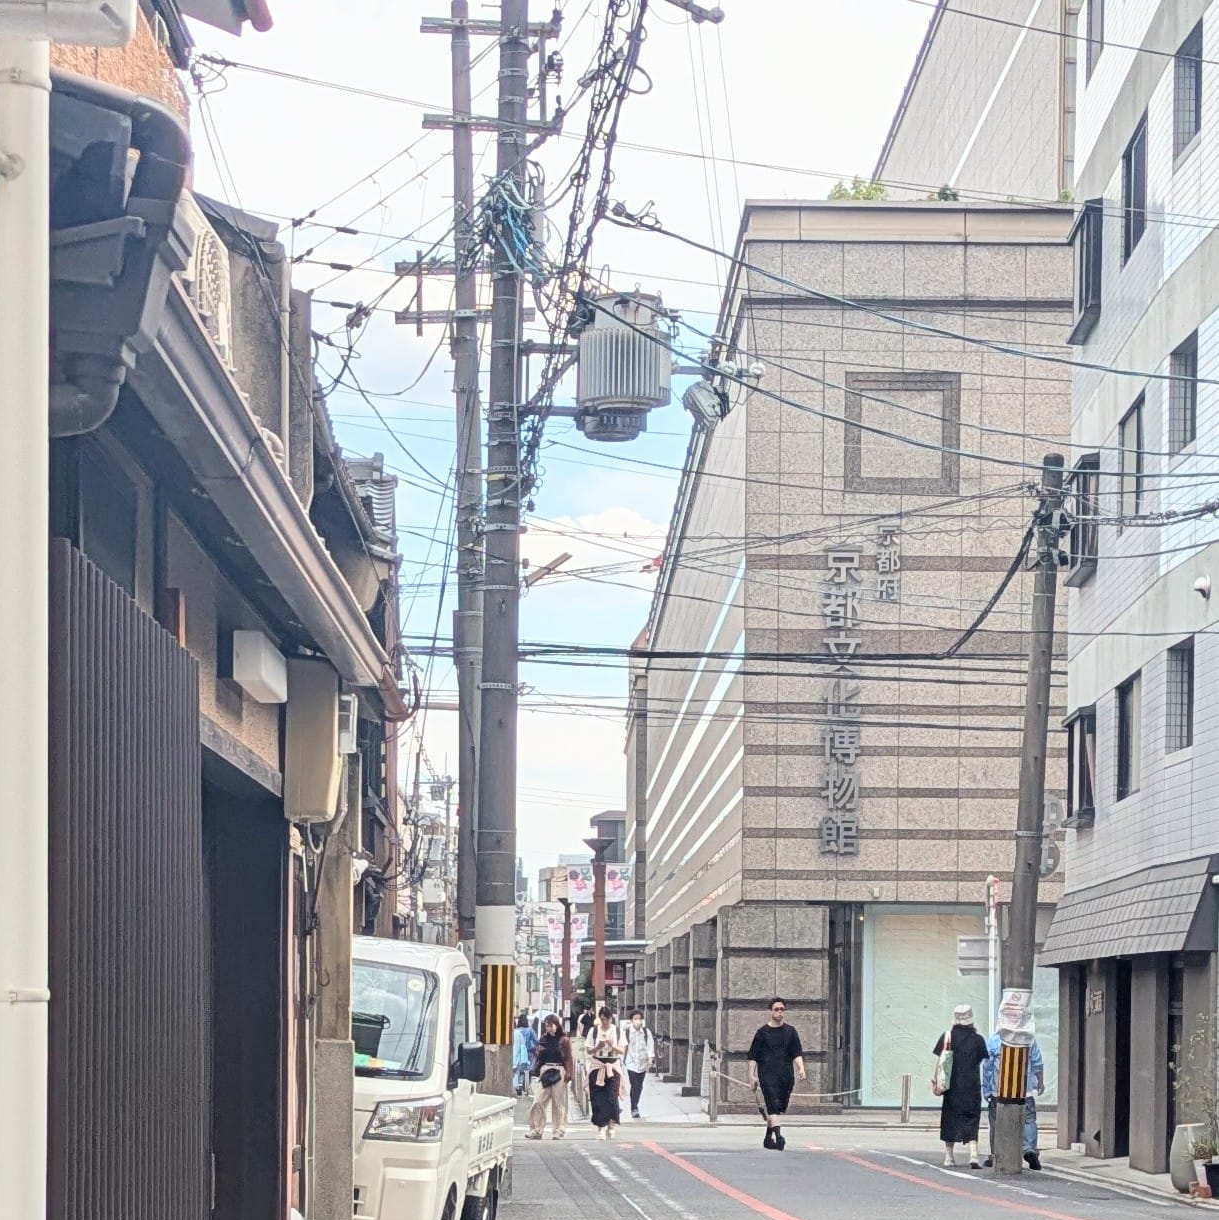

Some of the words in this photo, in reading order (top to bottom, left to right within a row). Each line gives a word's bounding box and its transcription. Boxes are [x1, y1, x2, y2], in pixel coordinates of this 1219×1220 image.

[877, 525, 901, 600] 京都府
[820, 545, 863, 855] 京都文化博物館
